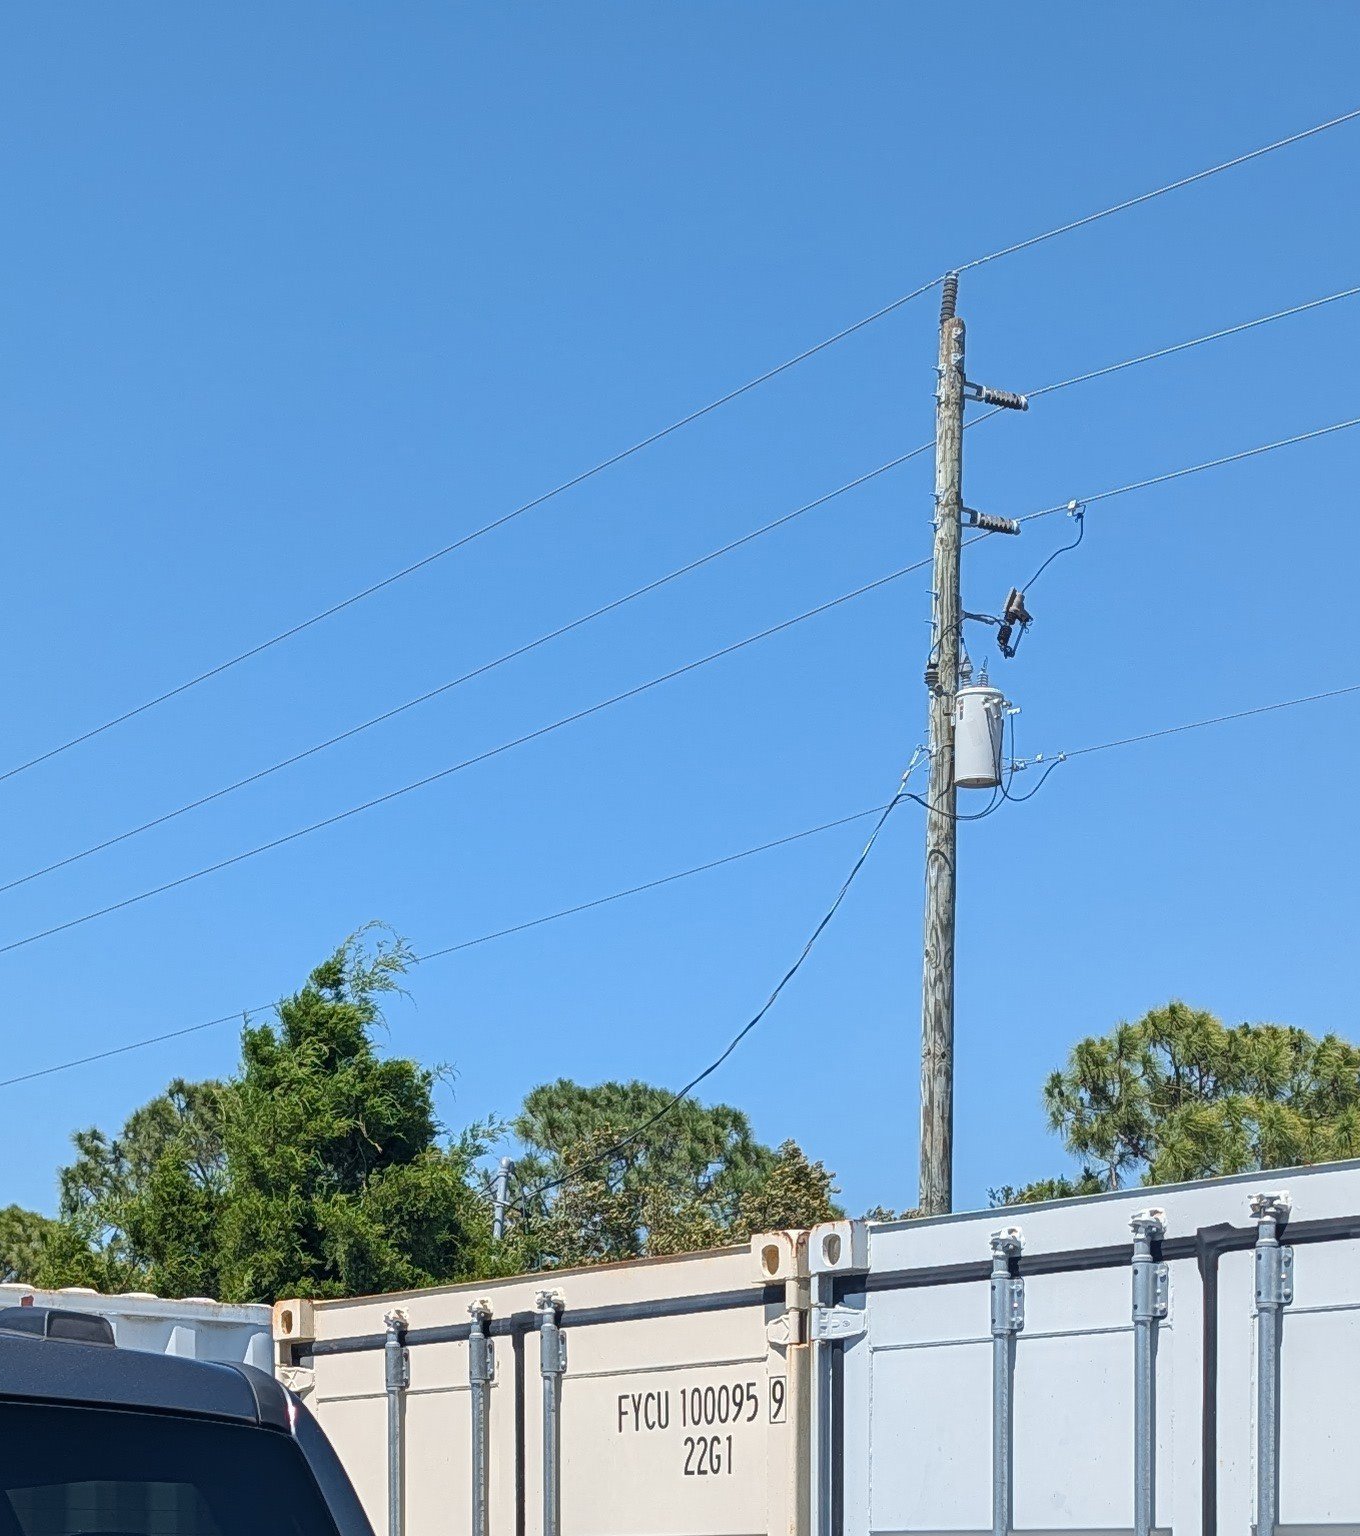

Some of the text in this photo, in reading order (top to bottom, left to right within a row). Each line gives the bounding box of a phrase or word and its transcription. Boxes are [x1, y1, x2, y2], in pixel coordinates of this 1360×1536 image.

[618, 1379, 785, 1433] FYCU 100095 9
[683, 1434, 733, 1476] 22G1
